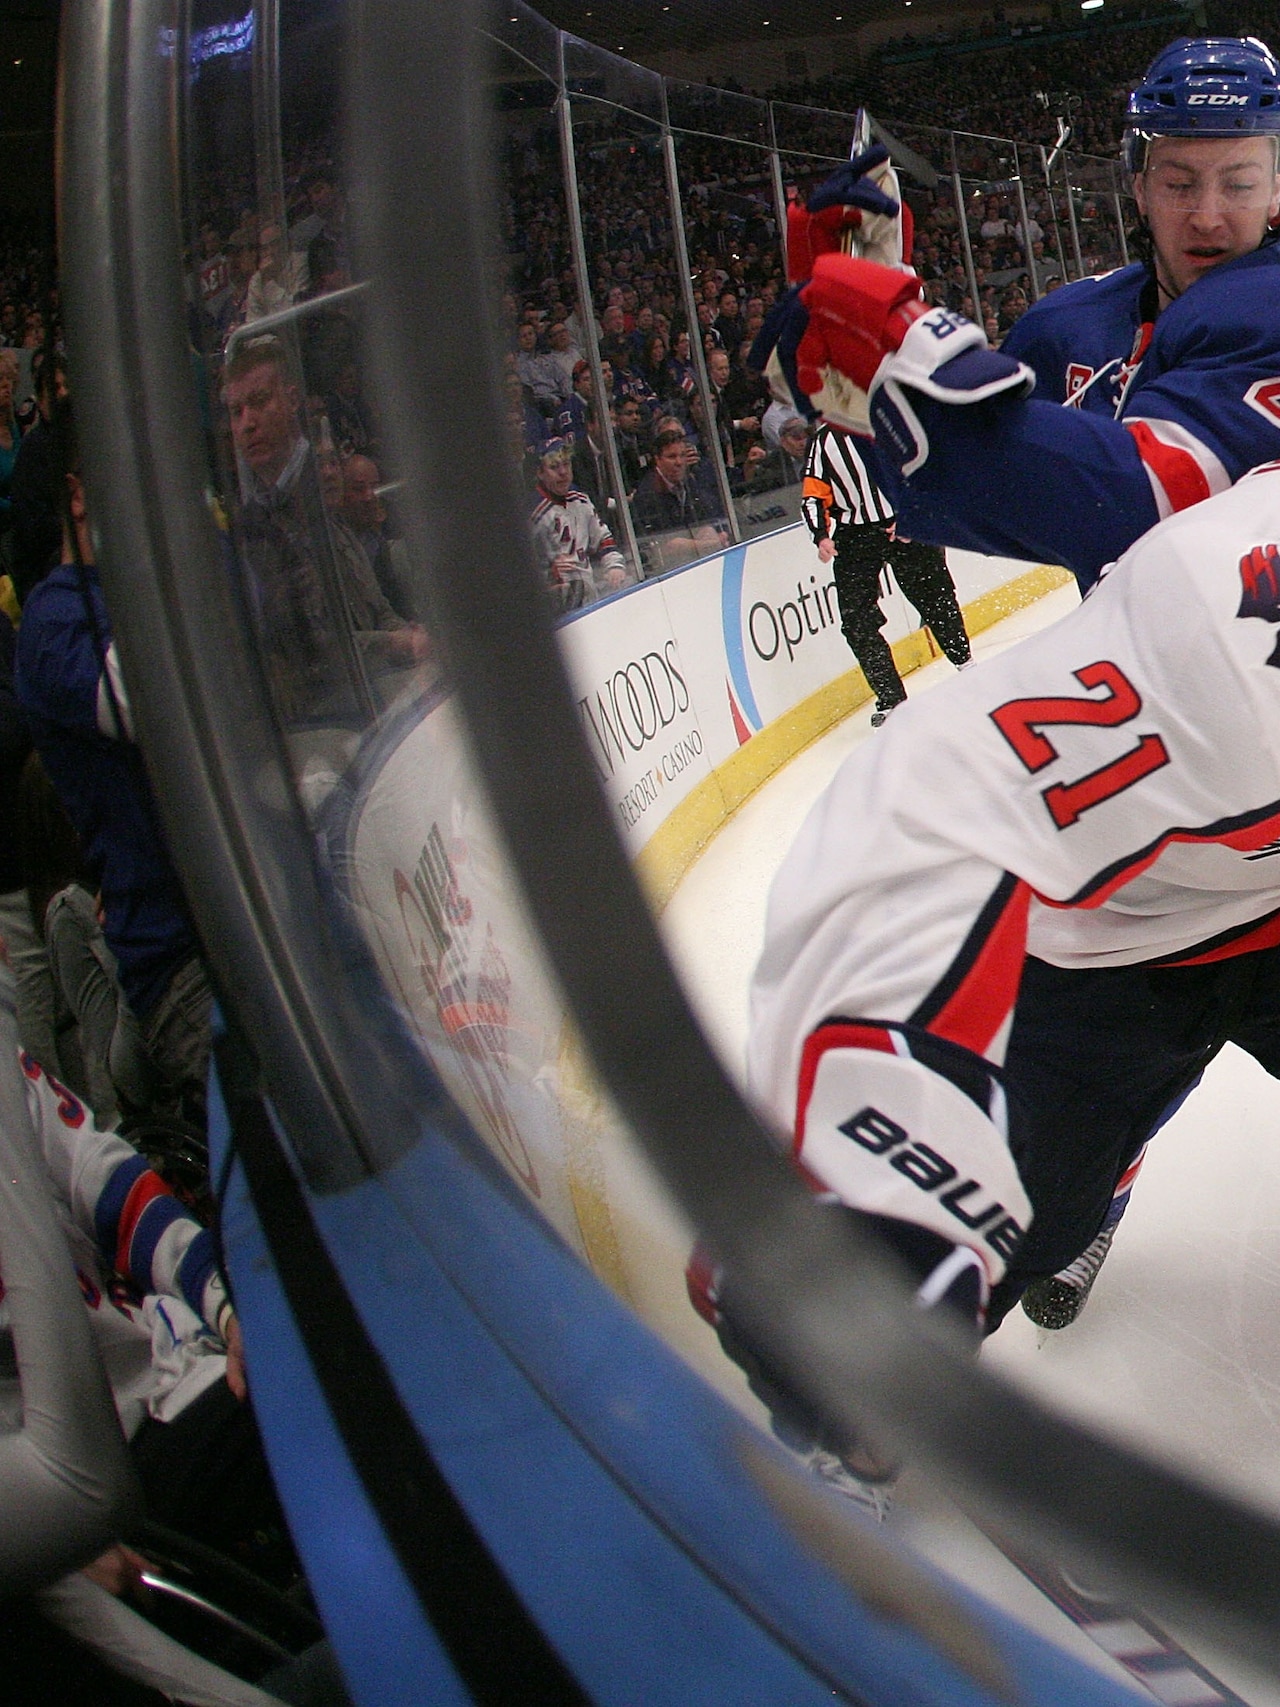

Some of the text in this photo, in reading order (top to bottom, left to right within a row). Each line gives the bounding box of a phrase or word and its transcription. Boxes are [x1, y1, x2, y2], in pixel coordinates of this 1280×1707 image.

[1187, 94, 1249, 106] CCM
[579, 639, 689, 780] WOODS
[988, 660, 1171, 831] 21
[618, 730, 704, 832] RESORT CASINO
[837, 1106, 1028, 1263] BAUE
